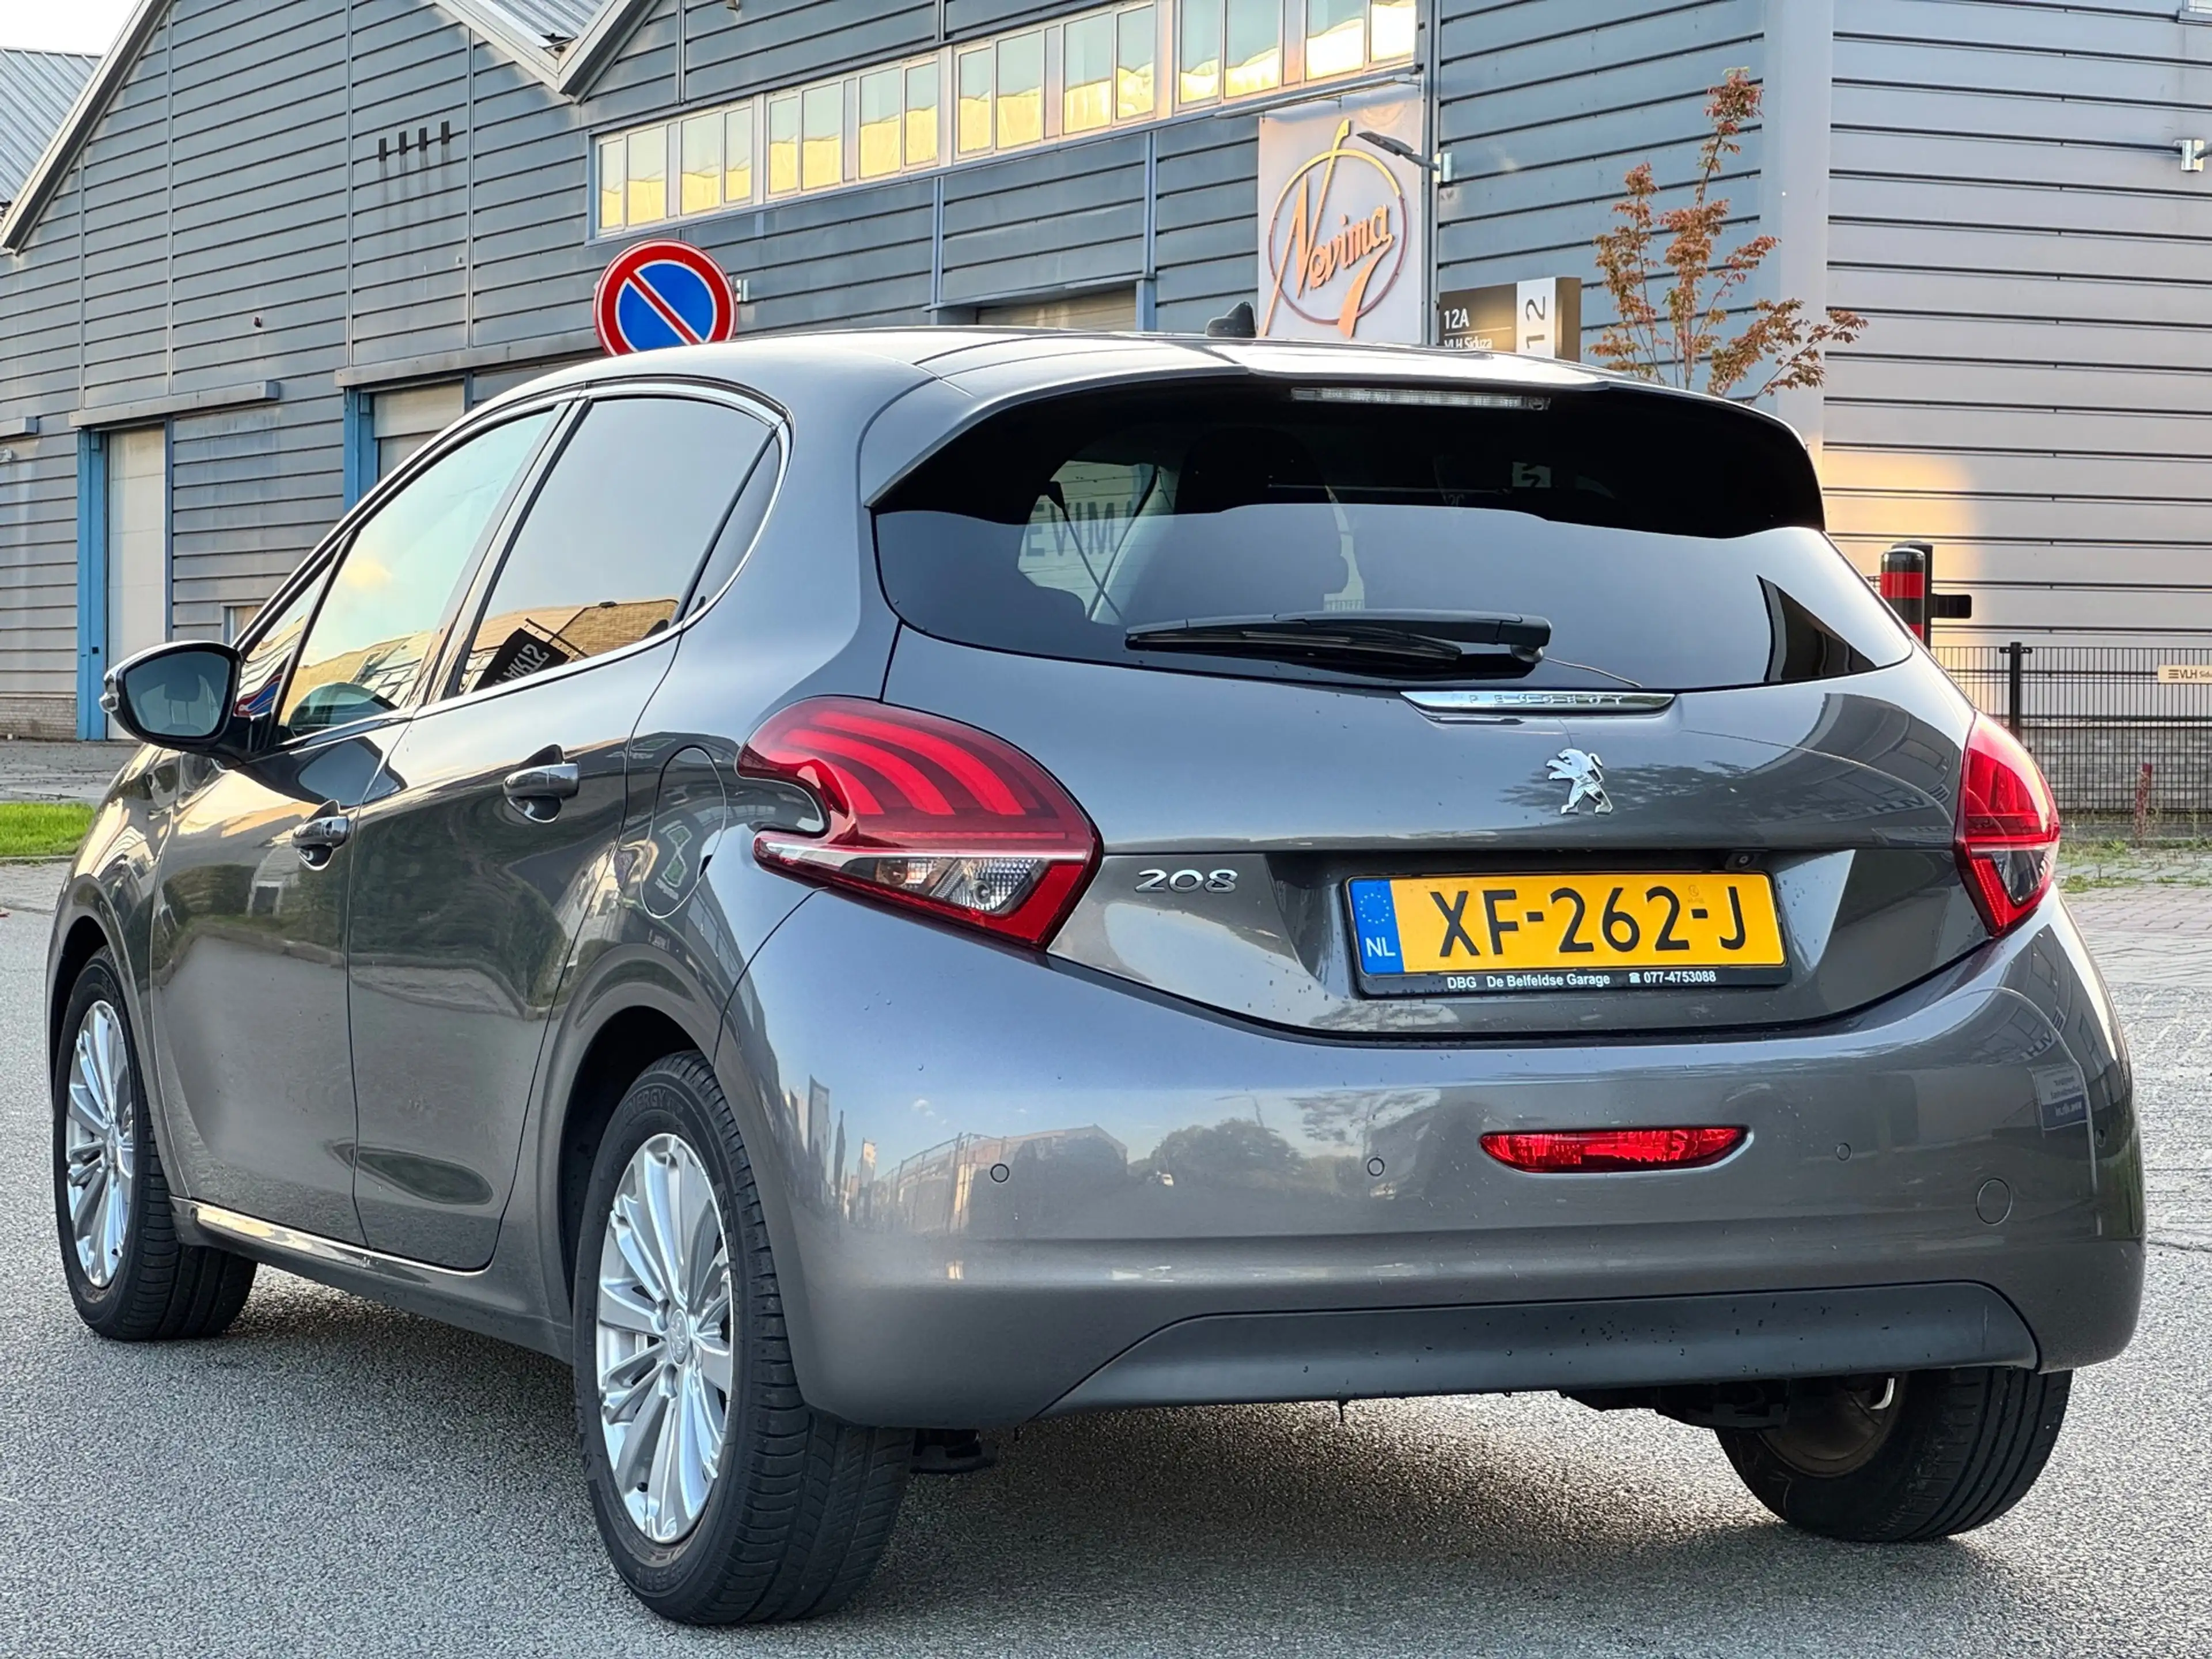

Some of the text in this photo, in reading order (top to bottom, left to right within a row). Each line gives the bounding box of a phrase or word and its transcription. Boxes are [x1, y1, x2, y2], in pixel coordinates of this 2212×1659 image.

[1444, 308, 1469, 329] 12A
[1526, 296, 1546, 349] 12
[2180, 669, 2198, 679] VLH
[1135, 868, 1238, 893] 208
[1429, 885, 1746, 957] XF-262-J
[1365, 937, 1396, 957] NL
[1446, 970, 1717, 989] DBG De Belfeldse Garage 077-4753088
